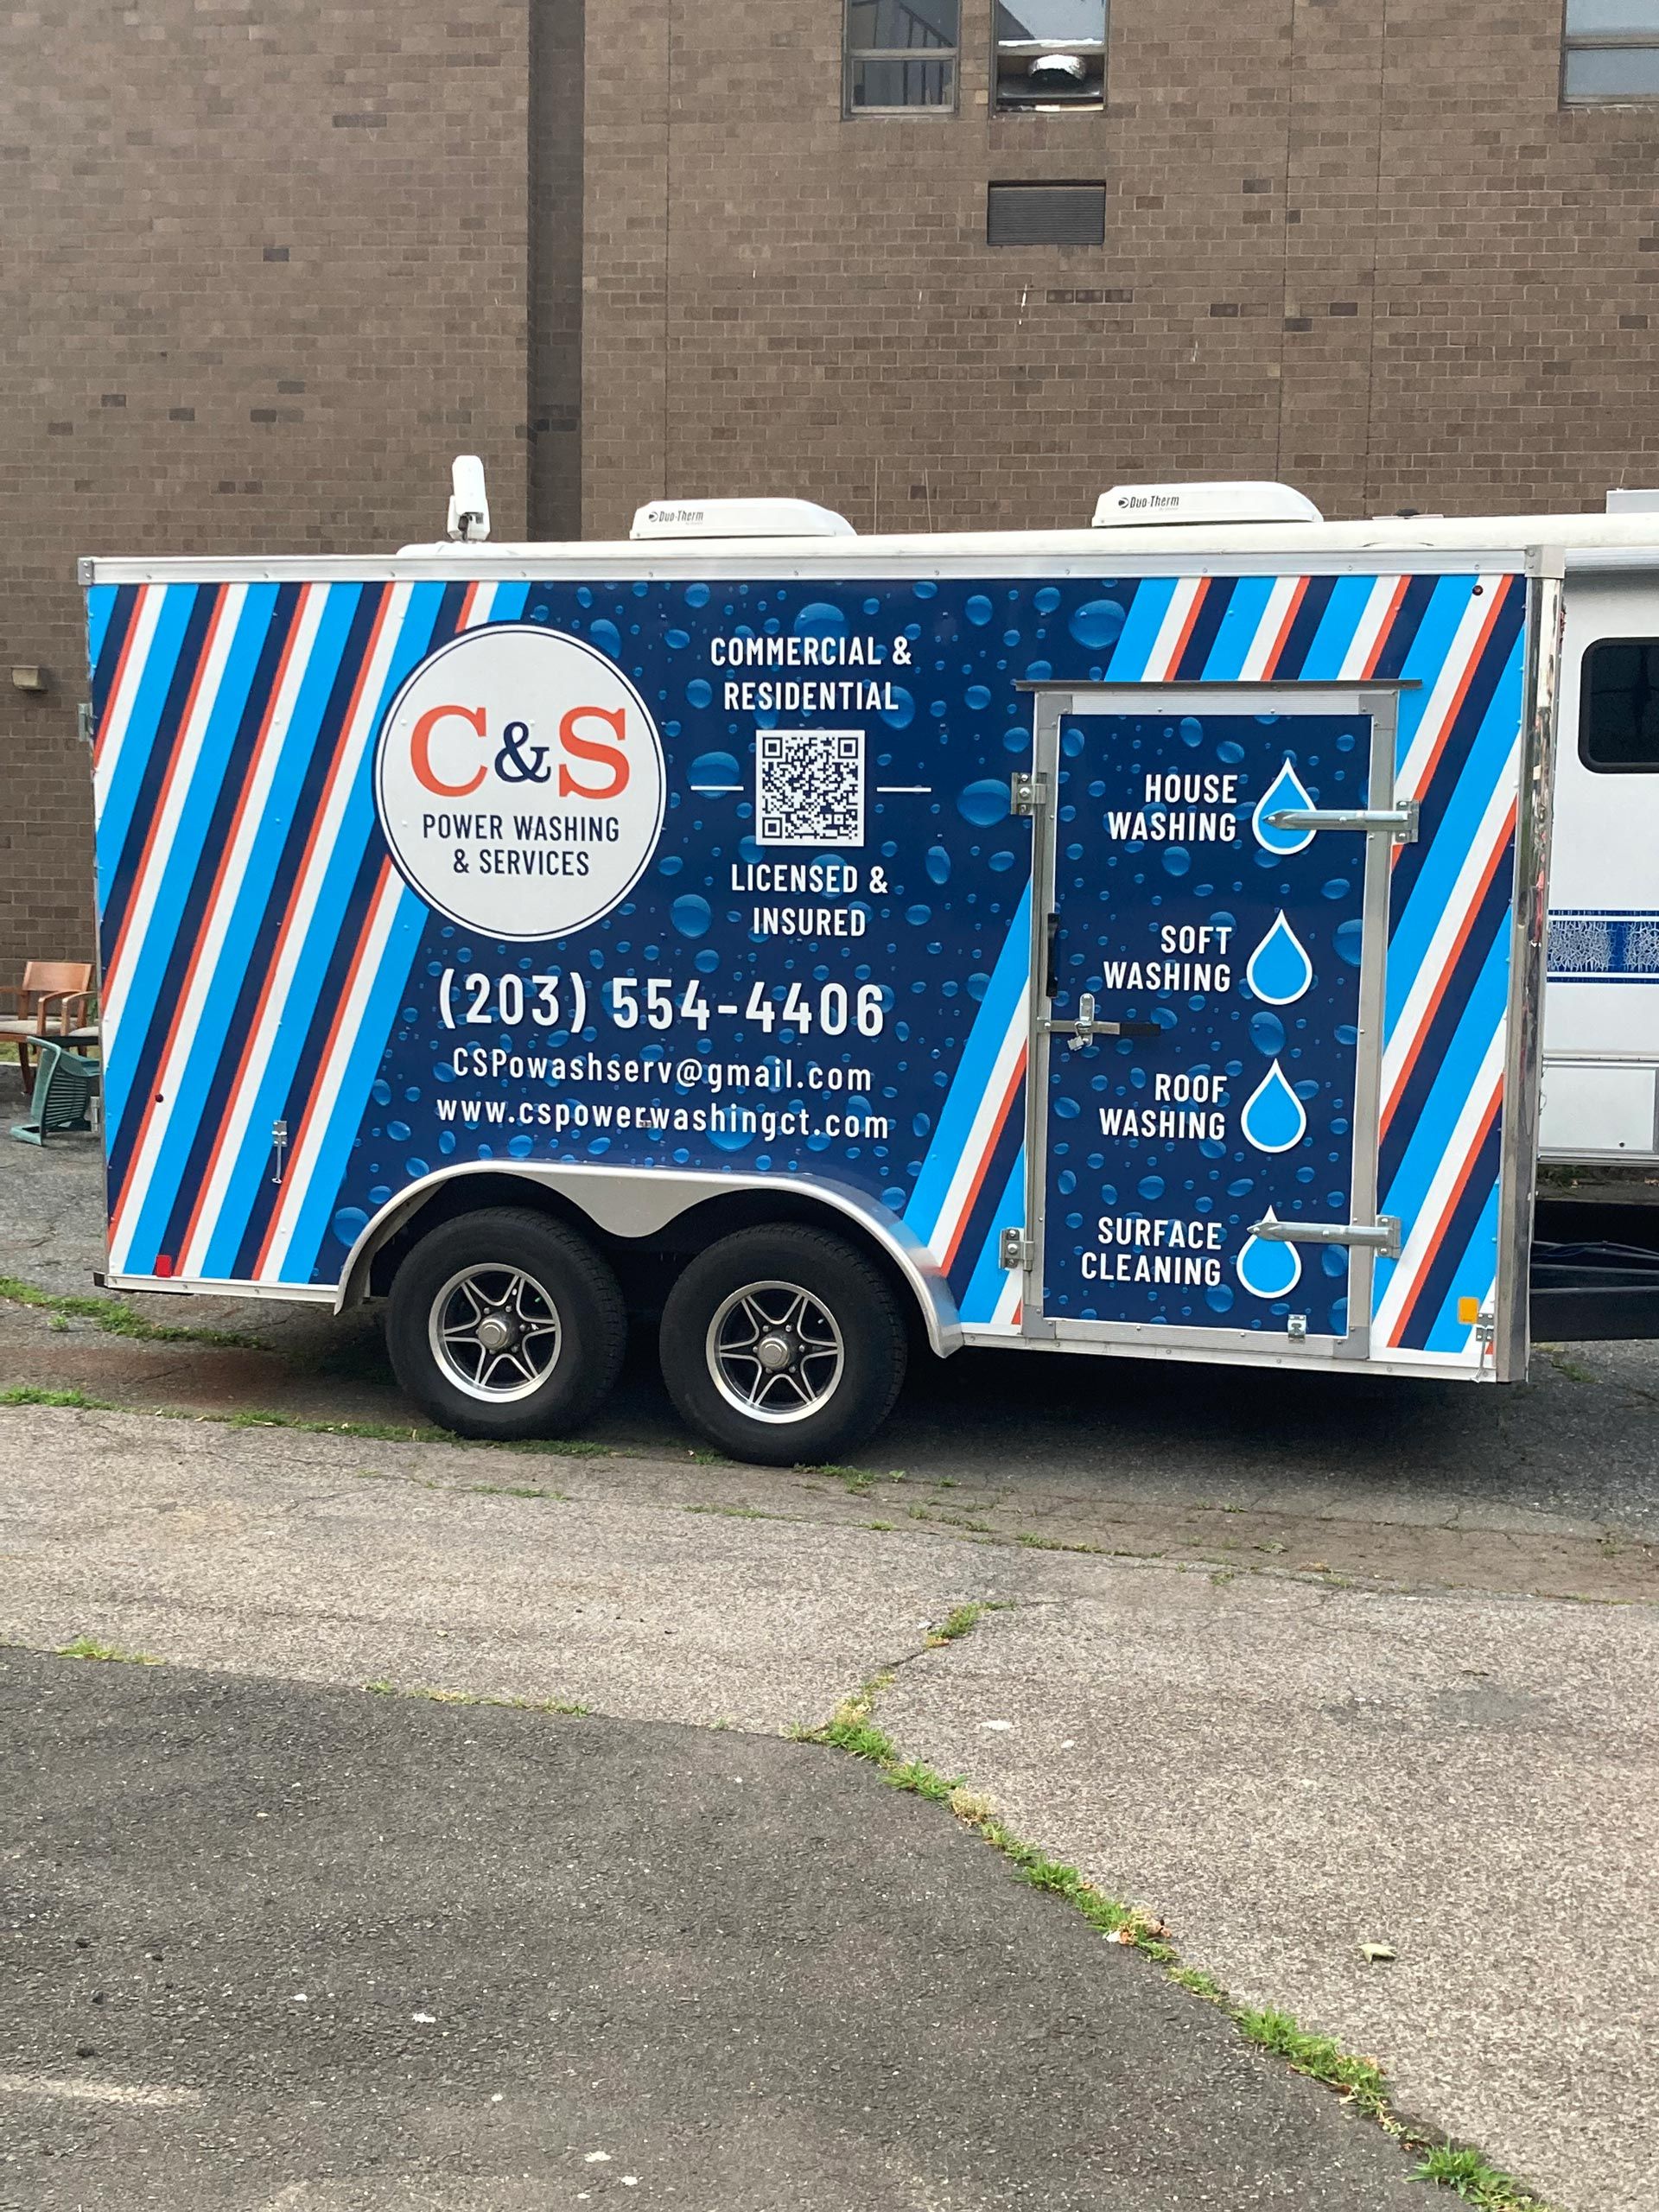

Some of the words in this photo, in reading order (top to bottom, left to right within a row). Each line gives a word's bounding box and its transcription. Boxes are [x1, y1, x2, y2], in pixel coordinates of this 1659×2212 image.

[659, 510, 704, 522] Duo-Therm
[1129, 495, 1179, 508] Duo-Therm
[710, 636, 882, 666] COMMERCIAL
[892, 639, 912, 665] &
[724, 682, 899, 710] RESIDENTIAL
[410, 705, 630, 800] C&S
[1145, 774, 1238, 804] HOUSE
[423, 814, 502, 841] POWER
[514, 816, 620, 842] WASHING
[1107, 811, 1236, 842] WASHING
[453, 849, 469, 874] &
[480, 849, 589, 877] SERVICES
[731, 863, 859, 893] LICENSED
[868, 866, 888, 894] &
[753, 906, 866, 938] INSURED
[1160, 925, 1232, 955] SOFT
[1103, 961, 1230, 992] WASHING
[439, 968, 587, 1033] (203)
[612, 976, 884, 1037] 554-4406
[453, 1046, 872, 1093] CSPowashserv@gmail.com
[1154, 1073, 1228, 1103] ROOF
[436, 1097, 888, 1141] www.cspowerwashingct.com
[1099, 1108, 1225, 1140] WASHING
[1097, 1216, 1223, 1250] SURFACE
[1081, 1252, 1221, 1287] CLEANING
